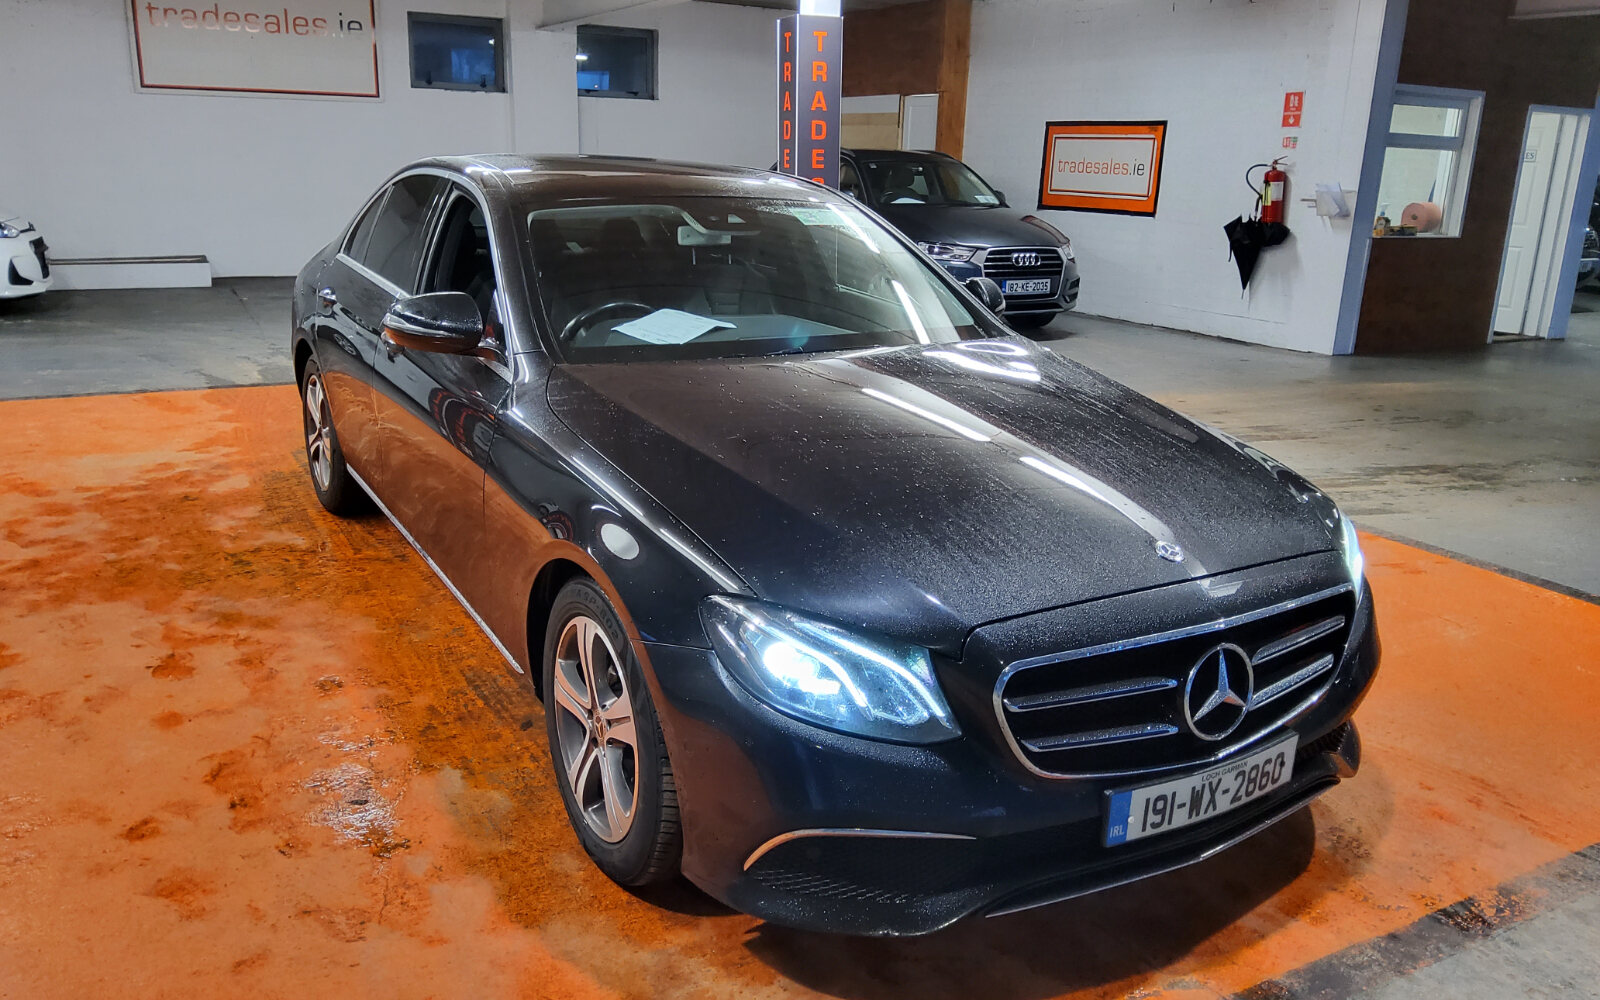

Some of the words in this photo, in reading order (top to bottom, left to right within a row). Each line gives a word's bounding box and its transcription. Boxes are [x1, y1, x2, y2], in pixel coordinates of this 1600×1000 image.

[145, 2, 363, 38] tradesales.ie
[1058, 157, 1145, 176] tradesales.ie
[1008, 281, 1049, 292] 182-KE-2035
[1201, 771, 1221, 782] LOCH
[1221, 761, 1249, 776] GARMAN
[1141, 751, 1286, 833] 191-WX-2860
[1109, 825, 1125, 838] IRL
